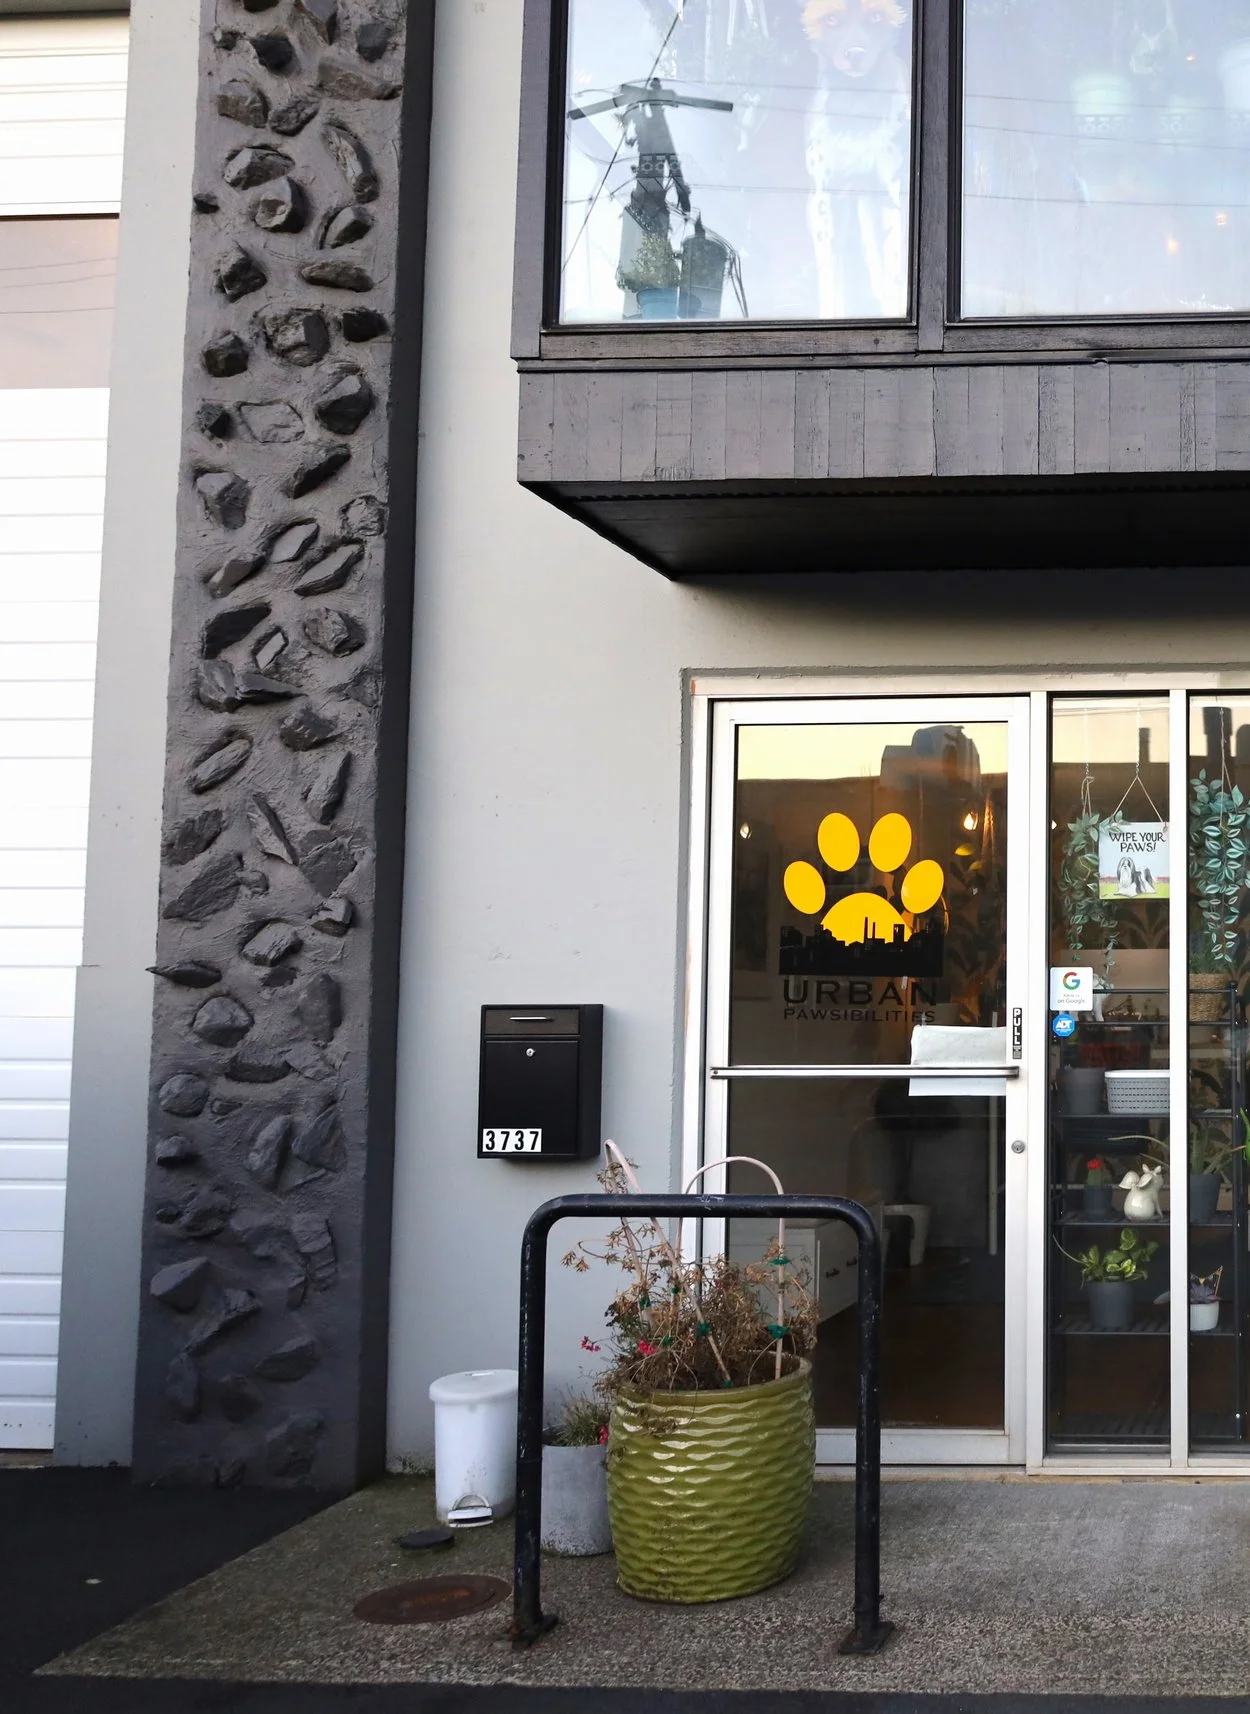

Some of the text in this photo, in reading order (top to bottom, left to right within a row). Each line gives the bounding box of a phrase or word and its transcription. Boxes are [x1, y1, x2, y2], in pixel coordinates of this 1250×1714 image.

[1109, 832, 1166, 842] WIPE YOUR
[1120, 842, 1156, 853] PAWS!
[783, 979, 937, 1006] URBAN
[784, 1008, 936, 1023] PAWSIBILITIES
[1013, 1008, 1022, 1045] PULL
[1056, 1019, 1072, 1029] ADT
[485, 1130, 539, 1151] 3737
